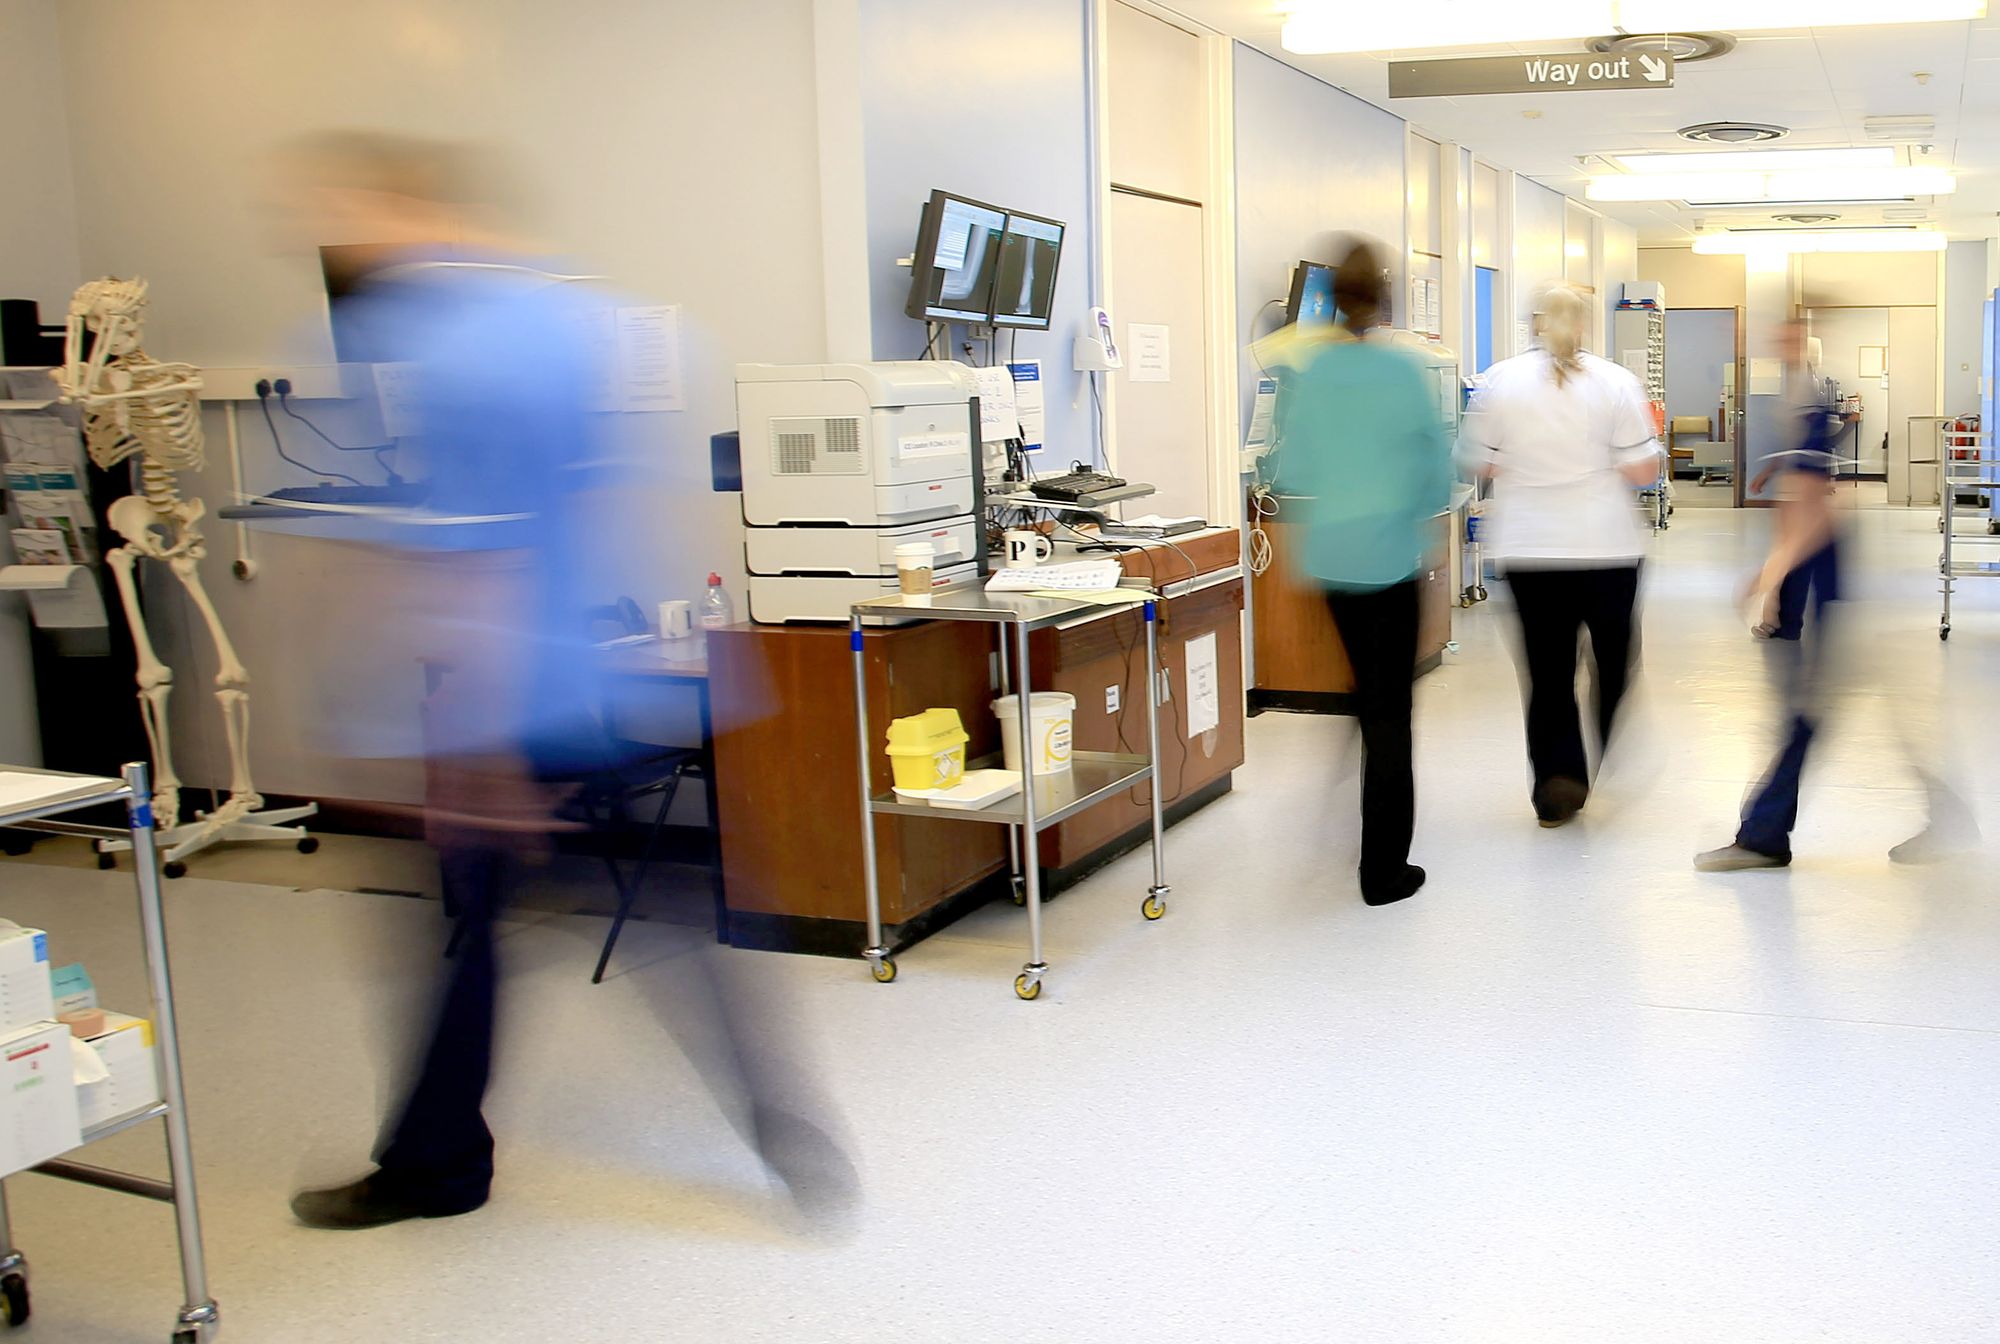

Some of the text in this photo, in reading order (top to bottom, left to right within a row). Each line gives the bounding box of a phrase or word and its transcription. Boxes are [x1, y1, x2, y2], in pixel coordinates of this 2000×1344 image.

[1525, 56, 1630, 85] Way out
[1009, 540, 1026, 561] P
